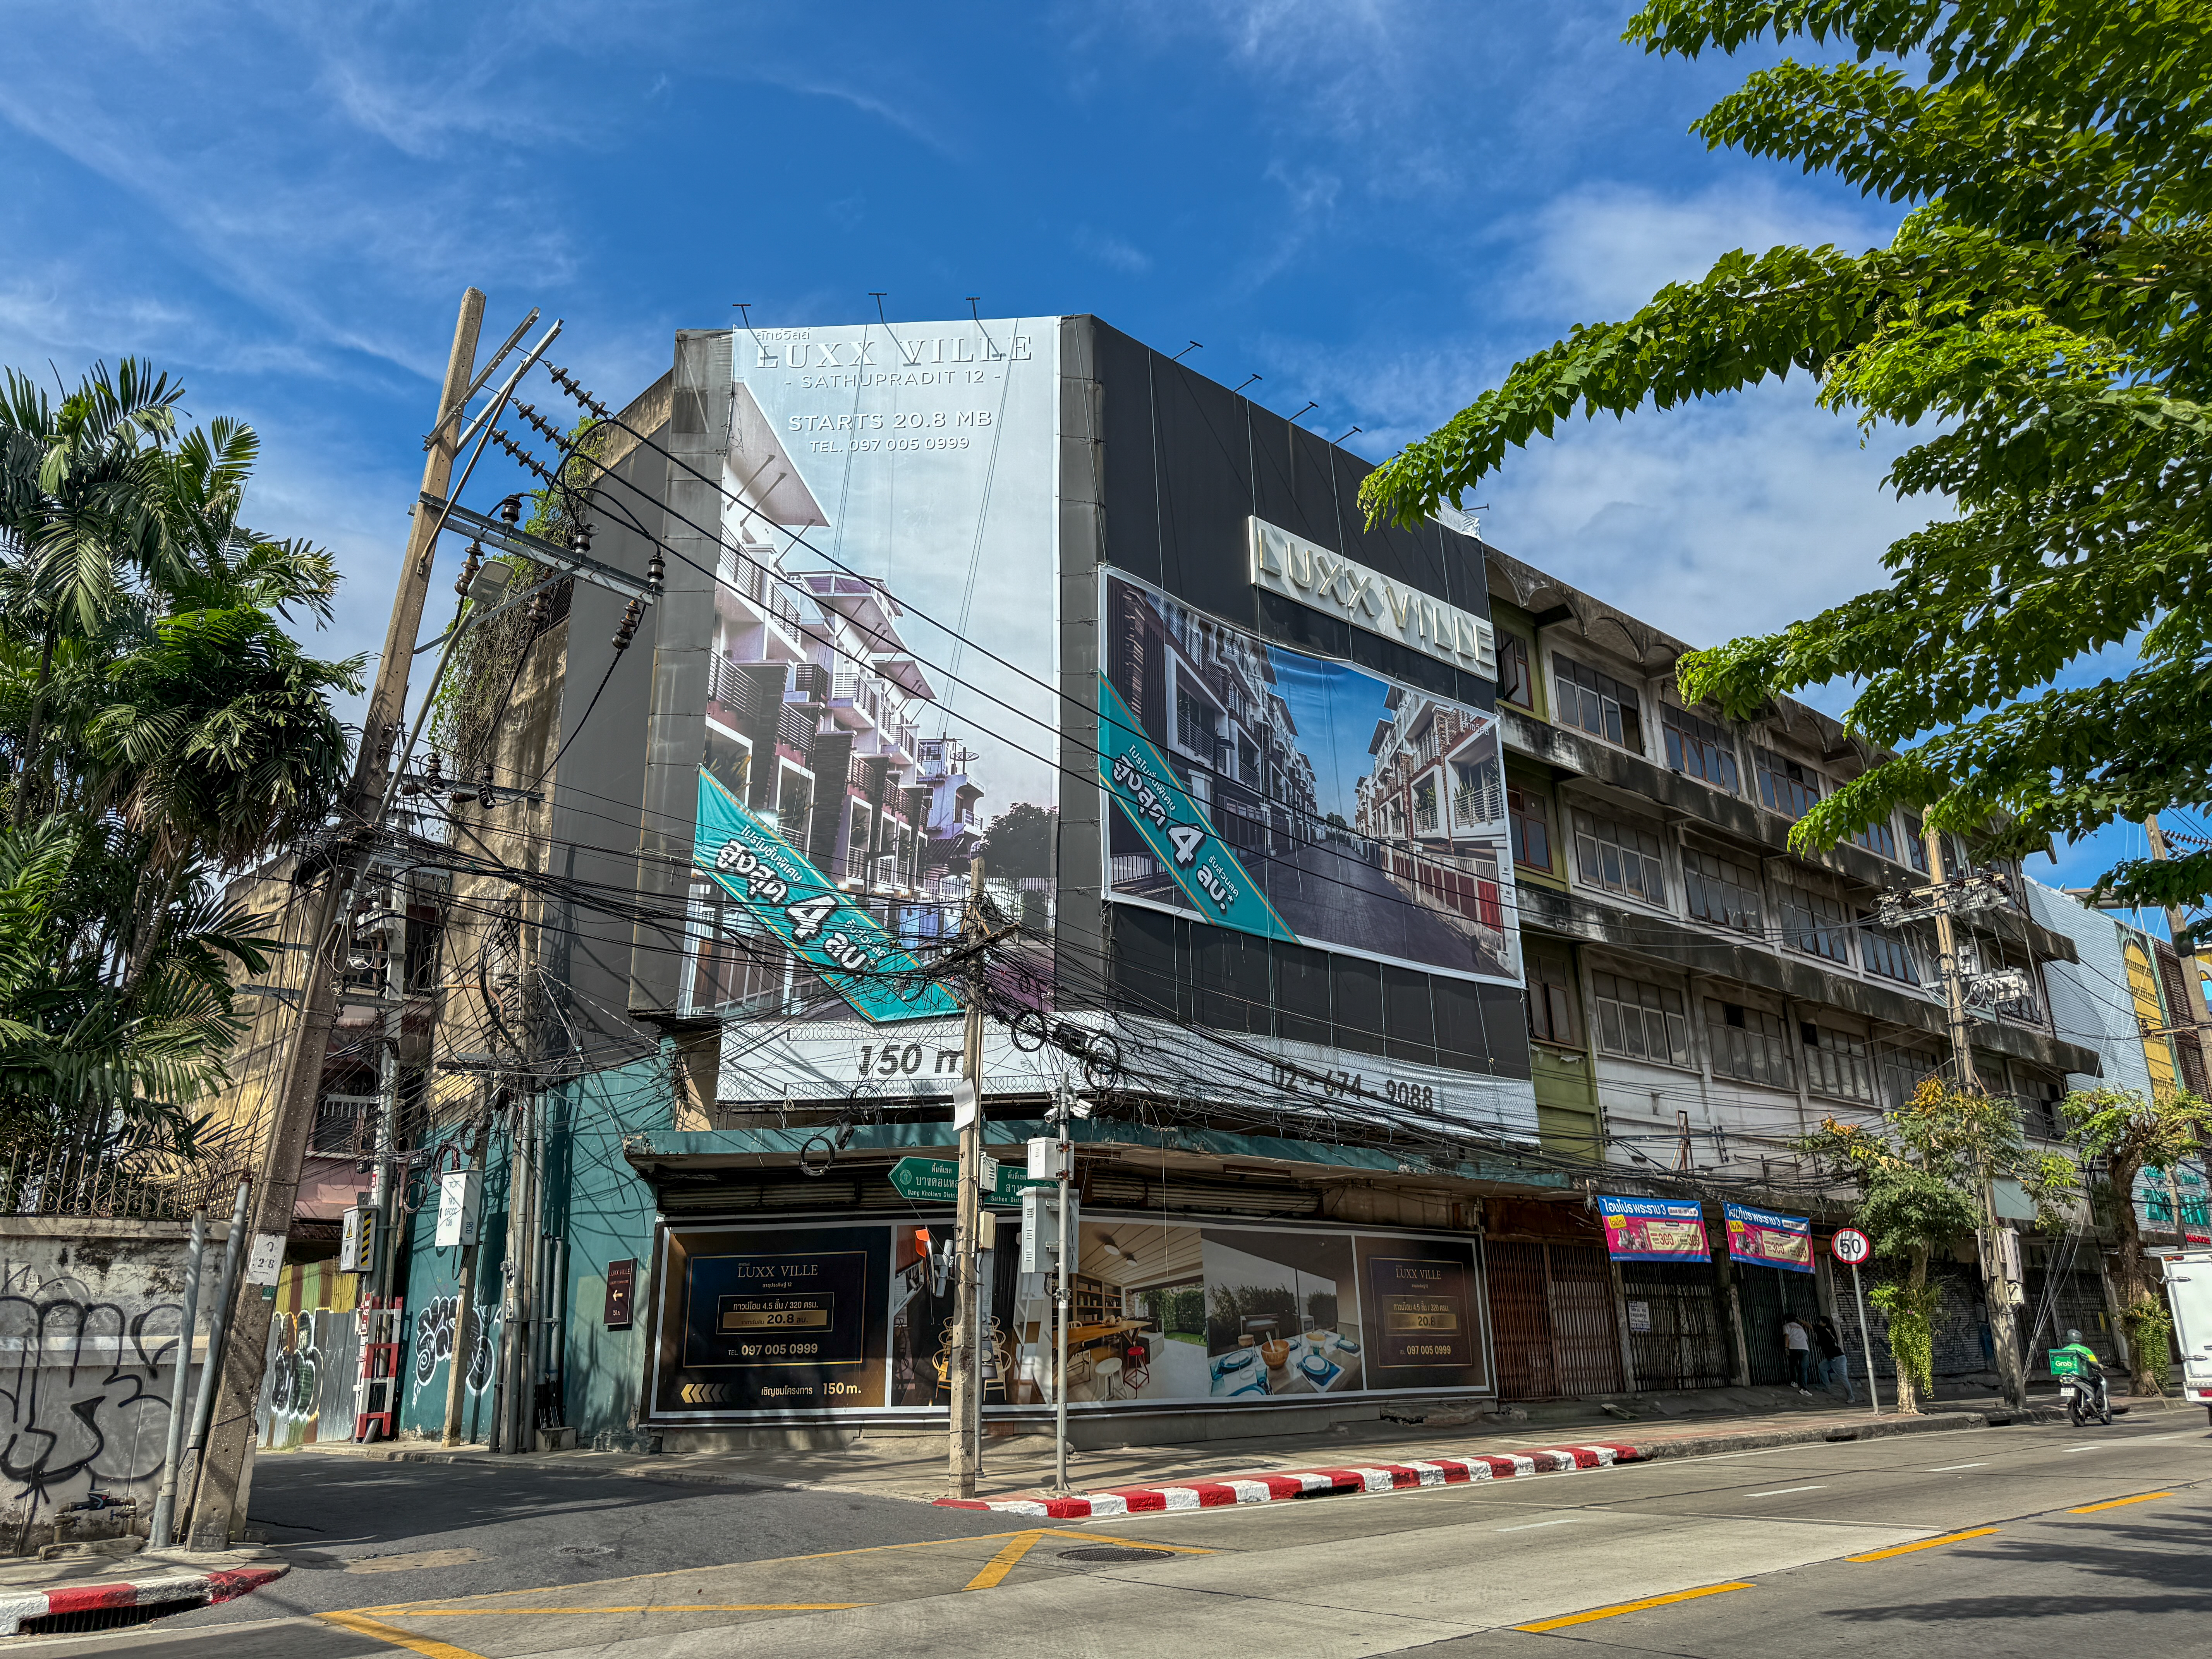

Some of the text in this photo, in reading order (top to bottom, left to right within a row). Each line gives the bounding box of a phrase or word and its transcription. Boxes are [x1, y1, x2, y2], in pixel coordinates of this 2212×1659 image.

[754, 336, 1031, 368] LUXX VILLE
[801, 371, 955, 388] SATHUPRADIT
[965, 370, 984, 383] 12
[788, 410, 992, 431] STARTS 20.8 MB
[810, 436, 969, 453] TEL. 097 005 0999
[1257, 528, 1495, 667] LUXX VILLE
[1113, 755, 1226, 910] สูงสุด 4 ลบ.
[740, 824, 803, 882] โปรโมชั่นพิเศษ
[1208, 855, 1239, 897] รับส่วนลด
[716, 839, 787, 904] สูงสุด
[787, 895, 836, 939] 4
[859, 1044, 923, 1075] 150
[931, 1162, 952, 1174] พื้นที่เขต
[1007, 1170, 1026, 1180] พื้นที่เขต
[916, 1176, 959, 1188] บางคอแหล
[465, 1221, 474, 1234] 038
[1840, 1239, 1861, 1254] 50
[737, 1264, 818, 1278] LUXX VILLE
[1396, 1268, 1441, 1279] LUXX VILLE
[733, 1301, 761, 1310] ทาวน์โฮม
[775, 1299, 783, 1309] ชั้น
[767, 1314, 794, 1324] 20.8
[1418, 1316, 1435, 1326] 20.8
[741, 1345, 762, 1355] 097
[765, 1344, 787, 1355] 005
[789, 1343, 818, 1354] 0999
[1407, 1345, 1419, 1355] 097
[1421, 1345, 1433, 1355] 005
[1435, 1345, 1451, 1355] 0999
[761, 1382, 862, 1397] เชิญชมโครงการ 150 m.
